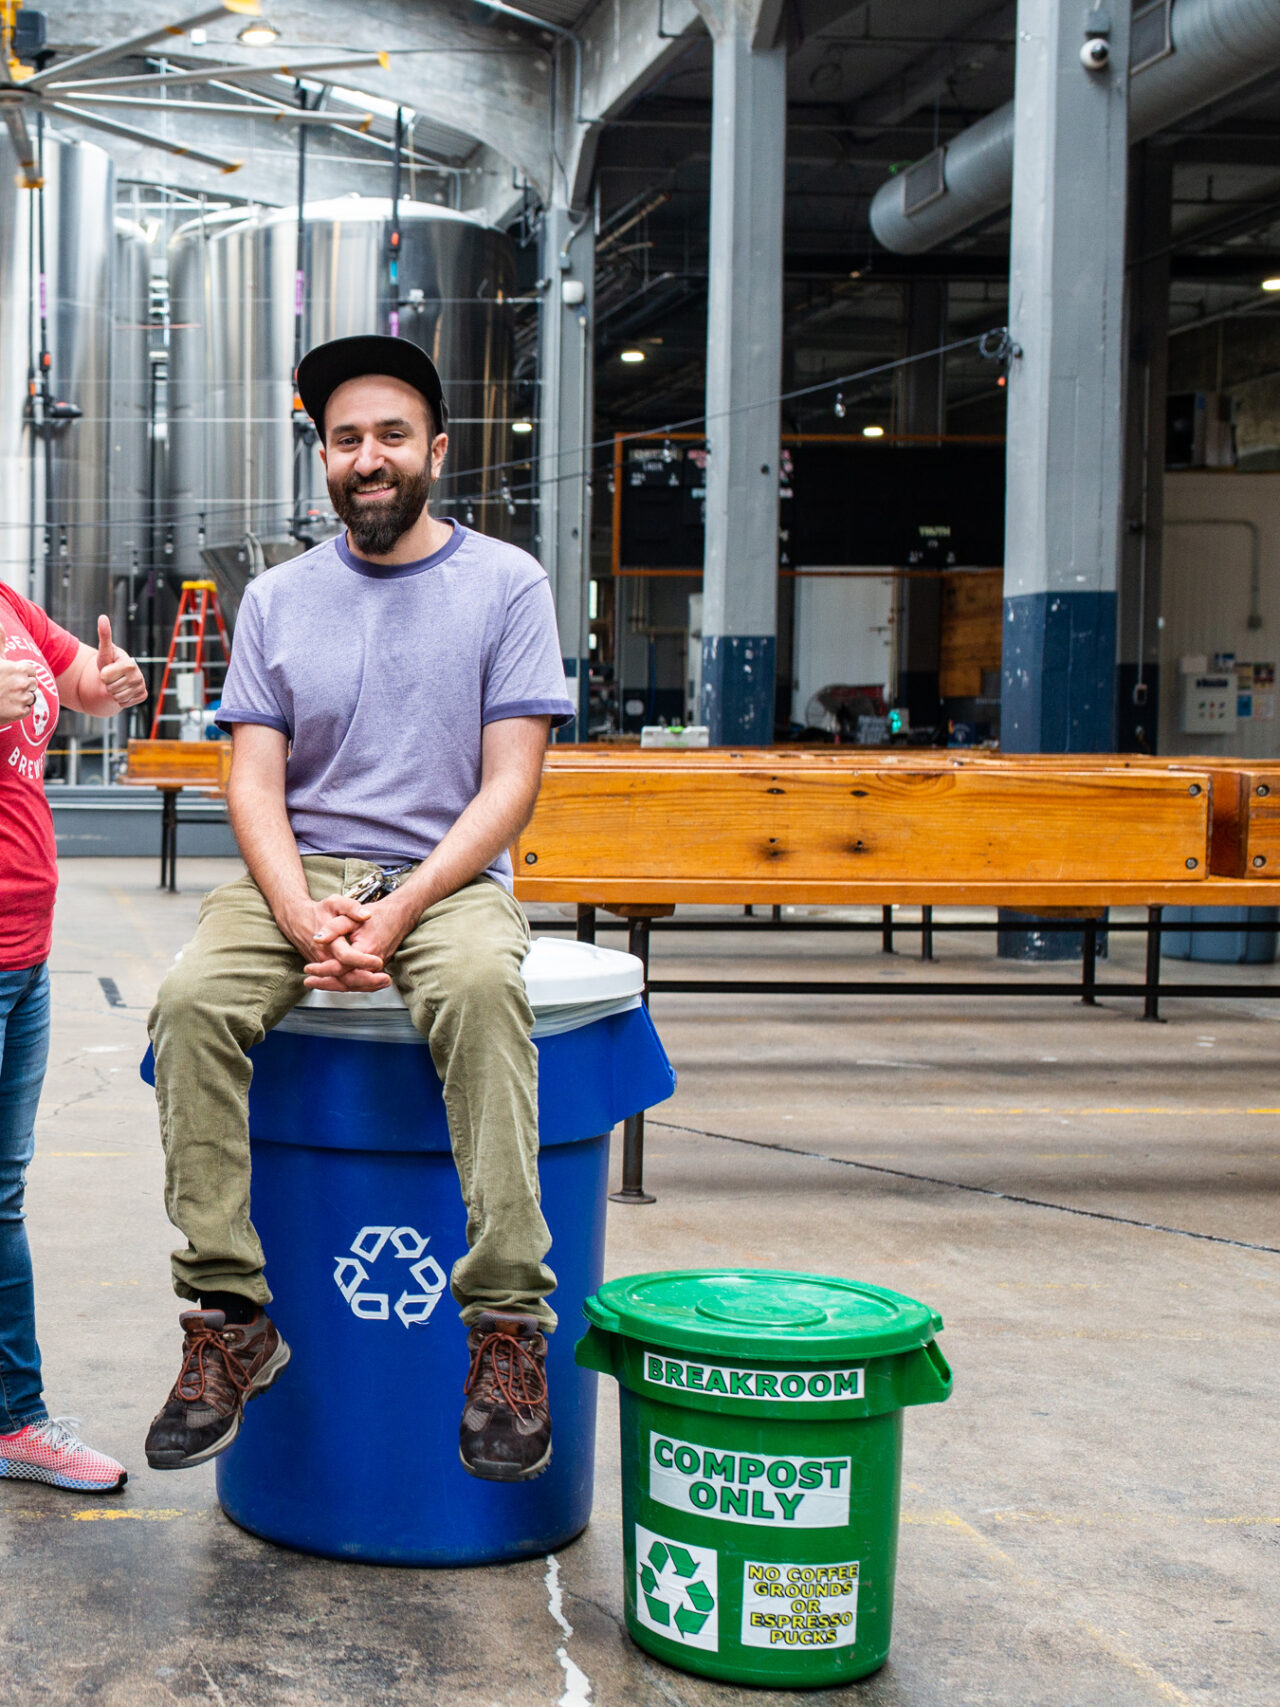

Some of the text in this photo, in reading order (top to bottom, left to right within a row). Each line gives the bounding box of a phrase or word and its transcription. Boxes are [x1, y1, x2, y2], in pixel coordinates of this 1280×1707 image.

[647, 1356, 859, 1399] BREAKROOM
[654, 1439, 848, 1489] COMPOST
[689, 1482, 805, 1521] ONLY
[748, 1564, 859, 1583] NO COFFEE
[753, 1580, 854, 1598] GROUNDS
[791, 1599, 822, 1615] OR
[750, 1611, 853, 1630] ESPRESSO
[770, 1629, 838, 1646] PUCKS
